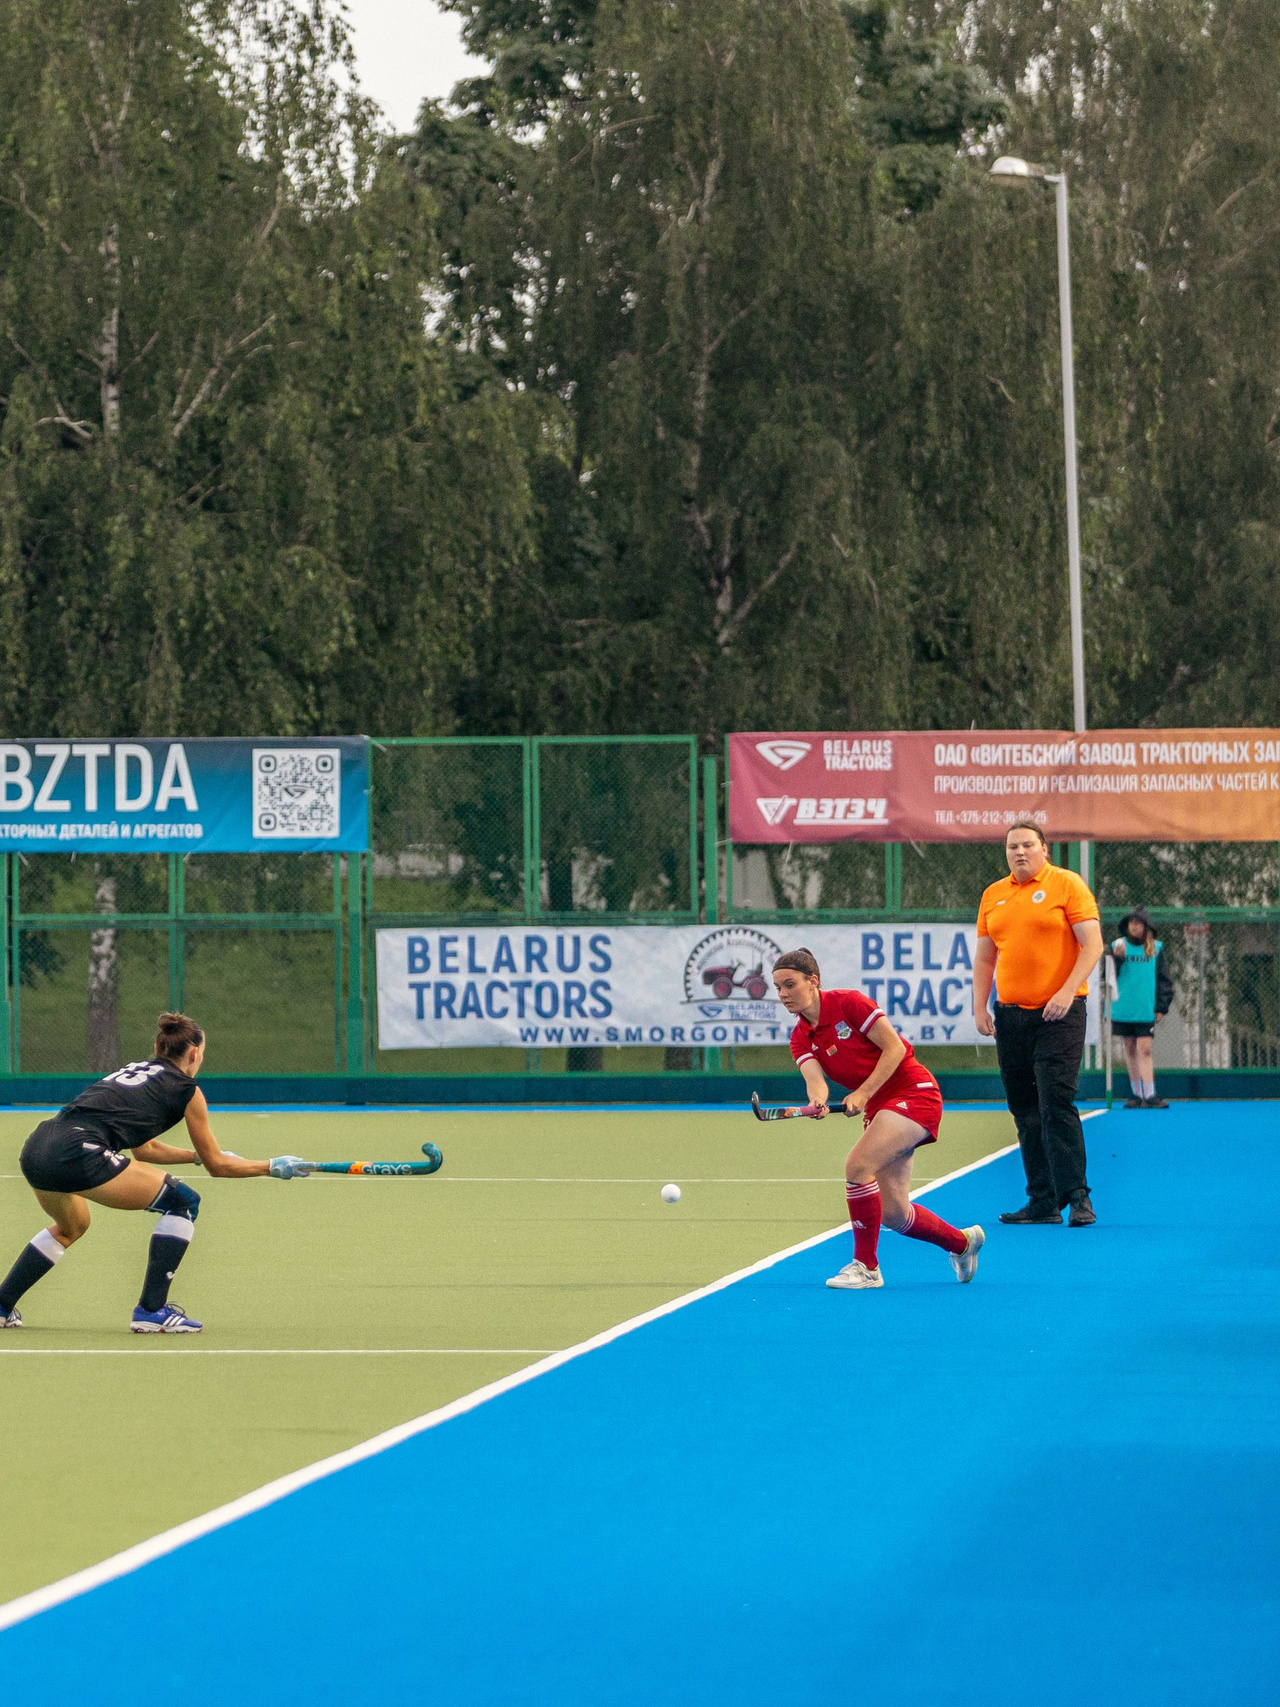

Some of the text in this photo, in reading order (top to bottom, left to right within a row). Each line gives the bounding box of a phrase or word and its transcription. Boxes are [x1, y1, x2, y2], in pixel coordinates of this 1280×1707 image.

[823, 739, 892, 754] BELARUS
[934, 743, 967, 767] ОАО
[1079, 742, 1137, 767] ЗАВОД
[1140, 741, 1250, 765] ТРАКТОРНЫХ
[824, 754, 892, 771] TRACTORS
[934, 770, 1279, 795] ПРОИЗВОДСТВО И РЕАЛИЗАЦИЯ ЗАПАСНЫХ ЧАСТЕЙ К
[59, 821, 119, 840] ДЕТАЛЕЙ
[121, 824, 131, 839] И
[133, 823, 203, 839] АГРЕГАТОВ
[407, 934, 612, 974] BELARUS
[861, 932, 974, 971] BELA
[408, 980, 613, 1019] TRACTORS
[861, 978, 976, 1016] TRAC
